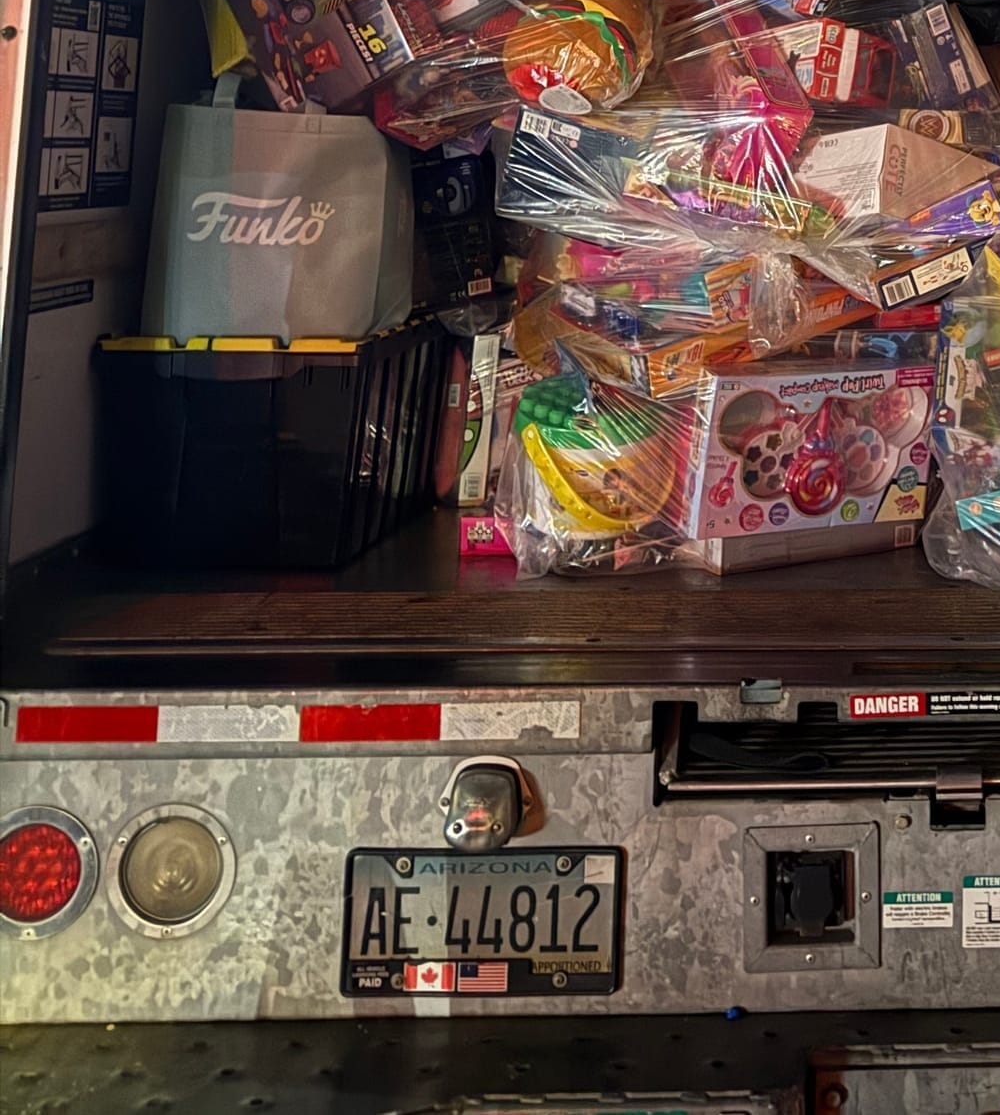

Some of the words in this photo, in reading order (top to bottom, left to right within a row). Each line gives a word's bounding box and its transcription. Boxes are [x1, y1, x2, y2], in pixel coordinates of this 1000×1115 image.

[345, 21, 373, 64] PIECES!
[358, 21, 388, 55] 16
[186, 191, 326, 247] Funko
[861, 374, 885, 392] Twirl
[854, 695, 919, 715] DANGER
[418, 861, 553, 875] ARIZONA
[896, 892, 942, 902] ATTENTION
[532, 960, 601, 973] APPORTIONED
[358, 976, 383, 989] PAID
